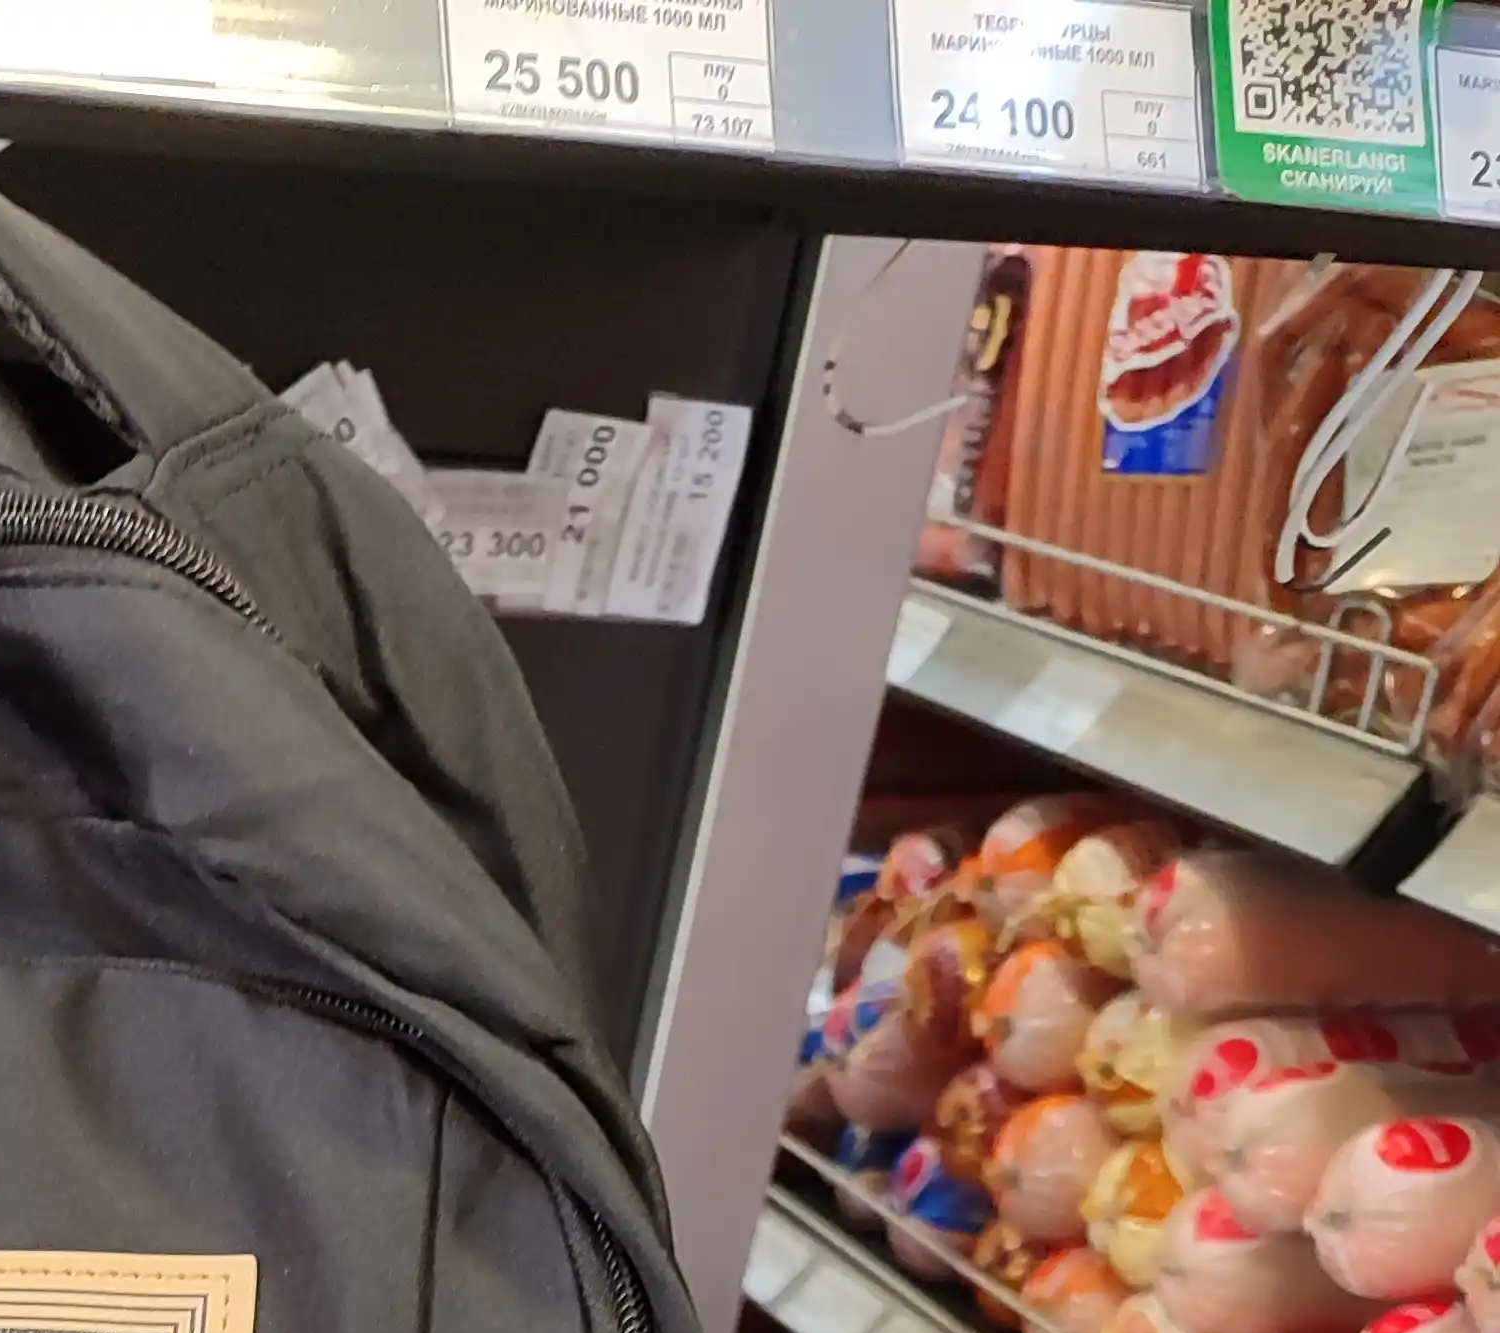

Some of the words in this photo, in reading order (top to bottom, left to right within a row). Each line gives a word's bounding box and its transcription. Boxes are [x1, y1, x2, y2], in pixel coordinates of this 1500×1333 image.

[653, 8, 693, 28] 1000
[699, 13, 726, 31] МЛ
[1086, 47, 1124, 66] 1000
[1129, 50, 1155, 68] МЛ
[484, 49, 541, 95] 25
[557, 55, 639, 104] 500
[931, 89, 980, 130] 24
[1001, 97, 1075, 139] 100
[1136, 152, 1167, 169] 661
[560, 504, 590, 544] 21
[576, 425, 616, 487] 000
[487, 531, 546, 557] 300
